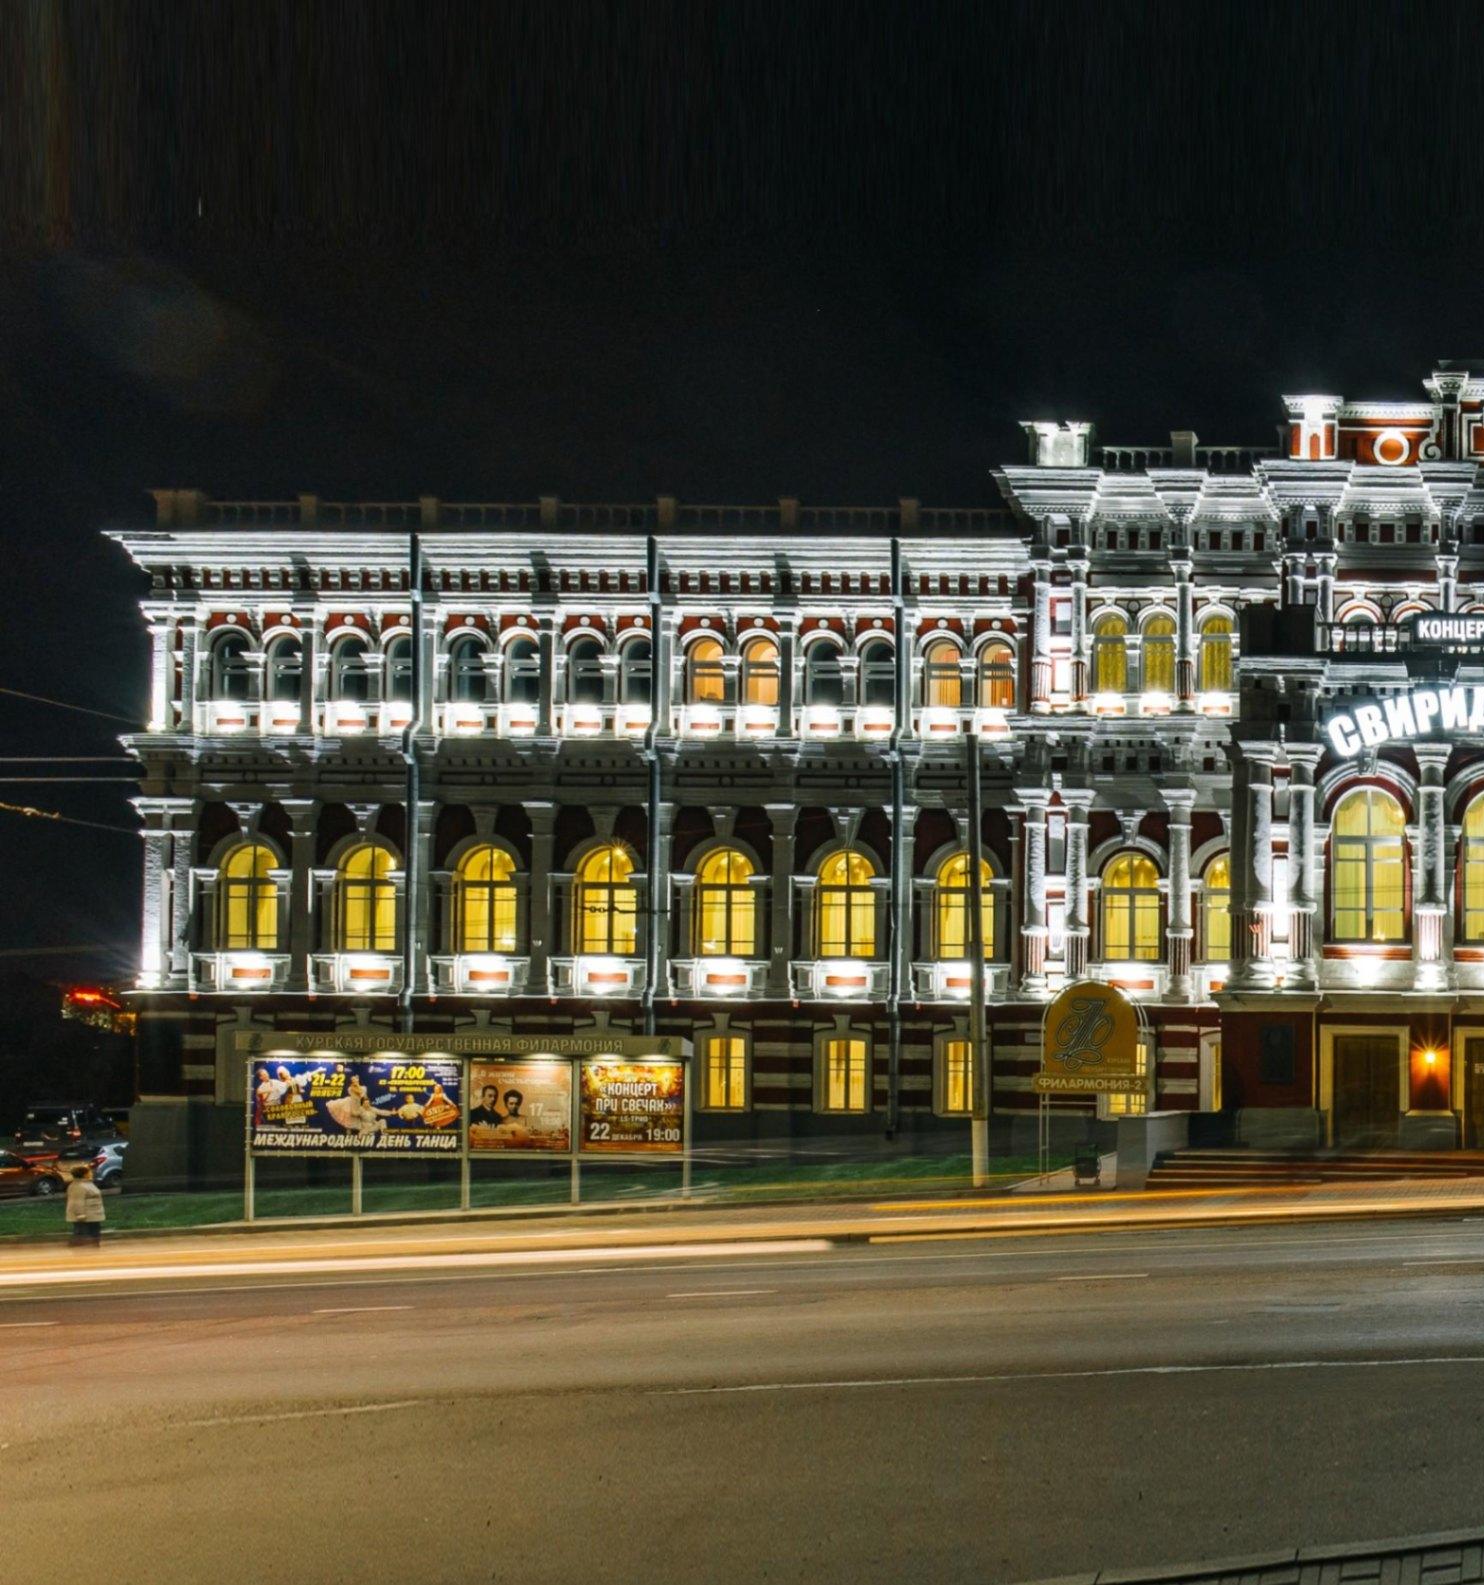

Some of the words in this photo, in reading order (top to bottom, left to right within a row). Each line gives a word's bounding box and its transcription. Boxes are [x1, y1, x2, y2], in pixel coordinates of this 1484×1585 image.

[296, 1036, 363, 1049] КУРСКАЯ
[369, 1037, 511, 1050] ГОСУДАРСТВЕННАЯ
[516, 1038, 624, 1052] ФИЛАРМОНИЯ
[391, 1066, 426, 1079] 17:00
[311, 1073, 346, 1087] 21-22
[1039, 1078, 1142, 1090] ФИЛАРМОНИЯ-2
[600, 1083, 658, 1097] «КОНЦЕРТ
[529, 1103, 544, 1116] 17
[595, 1098, 617, 1111] ПРИ
[621, 1098, 672, 1112] СВЕЧАХ»
[590, 1122, 610, 1140] 22
[646, 1128, 680, 1141] 19:00
[254, 1133, 375, 1148] МЕЖДУНАРОДНЫЙ
[376, 1135, 411, 1148] ДЕНЬ
[416, 1135, 457, 1149] ТАНЦА
